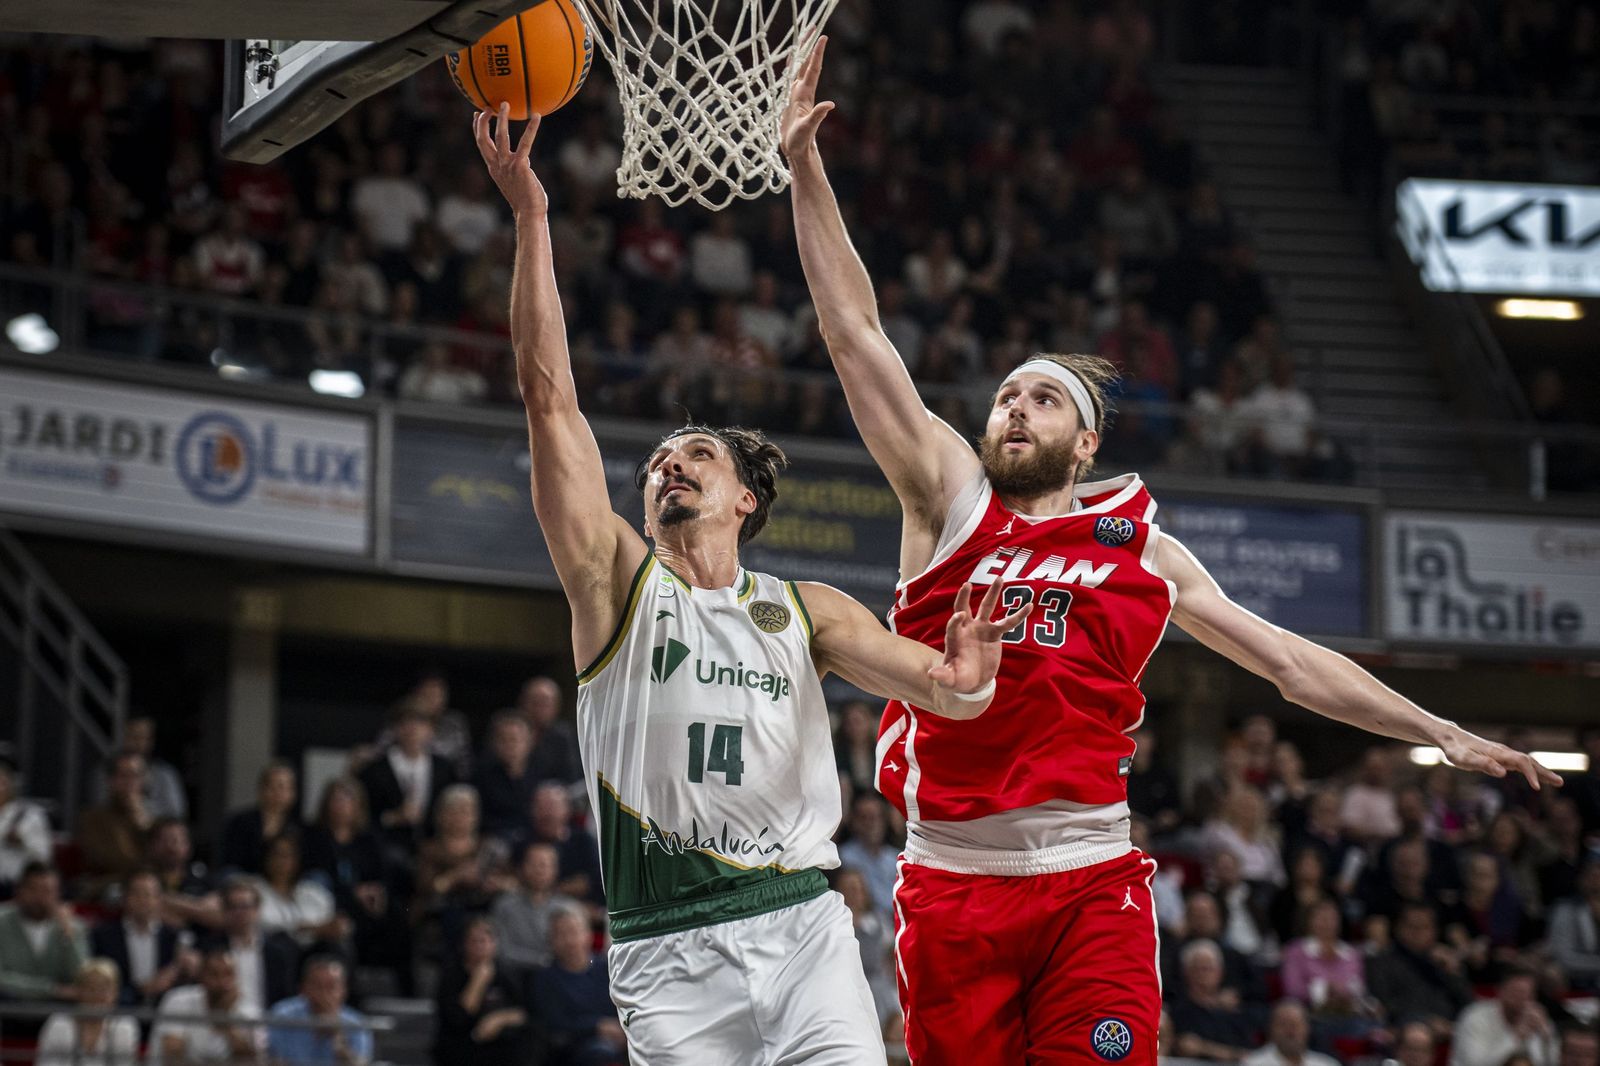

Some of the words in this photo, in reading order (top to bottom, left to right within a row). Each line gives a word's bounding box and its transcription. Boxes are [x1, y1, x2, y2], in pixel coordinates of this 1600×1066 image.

[494, 44, 511, 77] FIBA
[1001, 585, 1074, 649] 33
[1402, 585, 1584, 643] Thalie
[695, 658, 790, 702] Unicaja
[687, 721, 745, 786] 14
[640, 815, 786, 857] Andalucía
